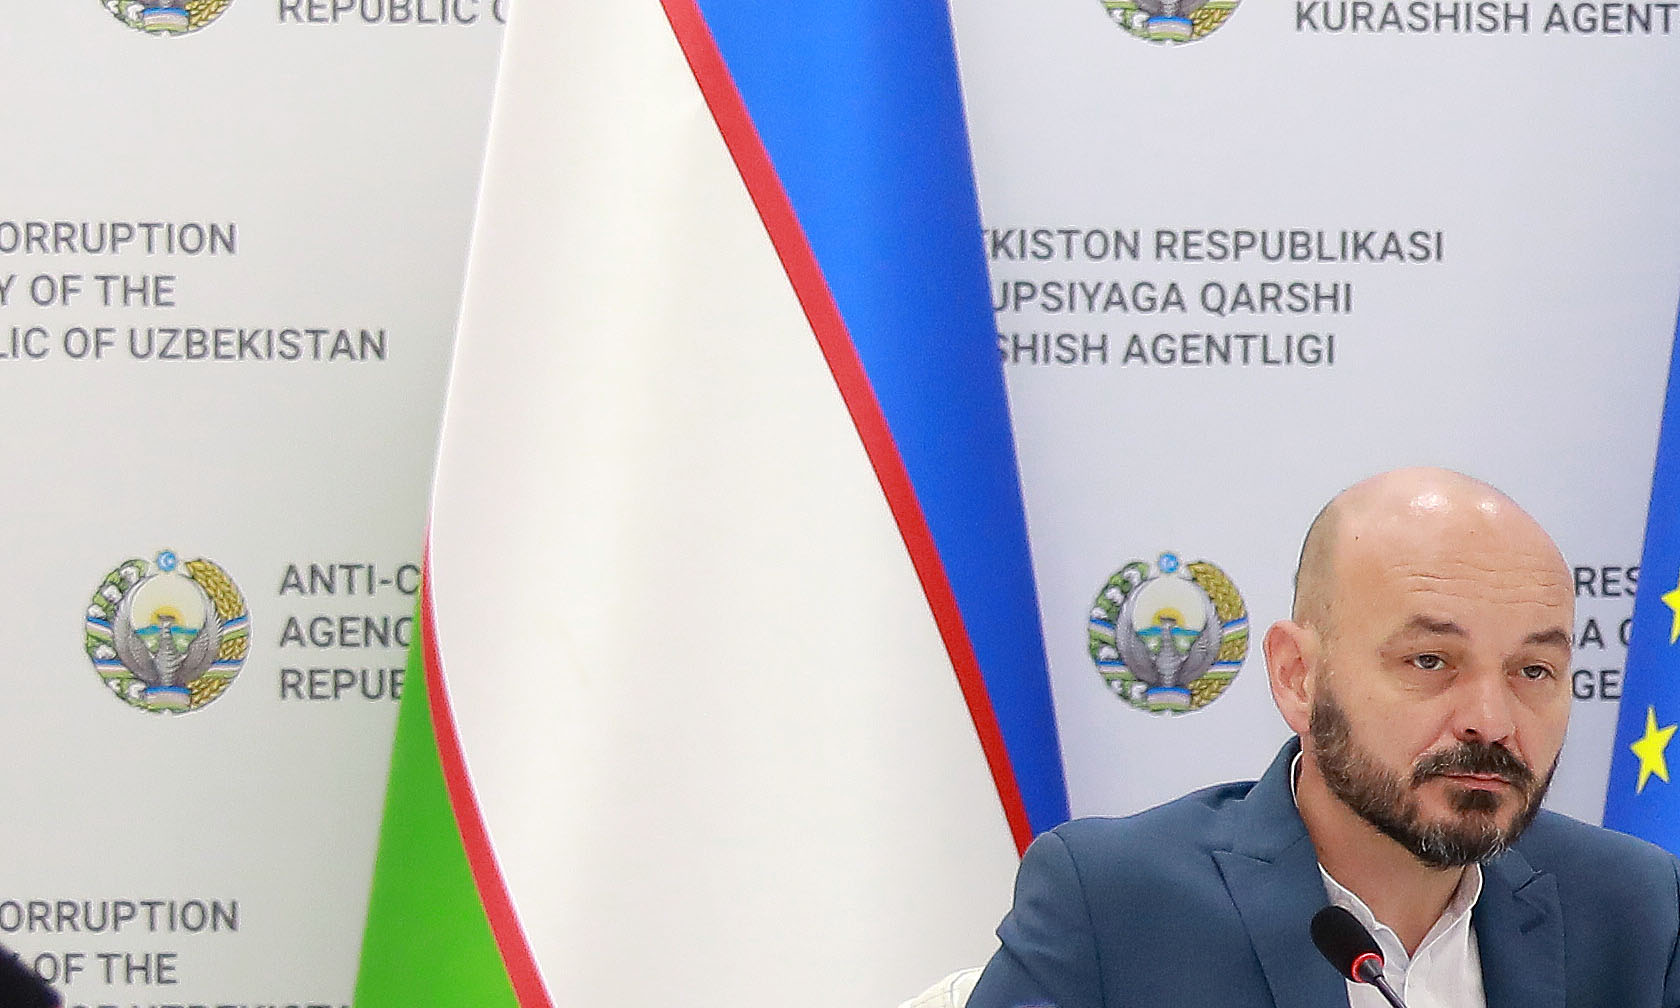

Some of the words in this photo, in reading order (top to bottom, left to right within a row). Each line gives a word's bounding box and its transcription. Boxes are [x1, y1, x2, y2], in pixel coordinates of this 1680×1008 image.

[1295, 0, 1530, 34] KURASHISH
[983, 228, 1141, 263] KISTON
[1154, 228, 1444, 263] RESPUBLIKASI
[29, 273, 83, 307] OF
[93, 274, 177, 308] THE
[1200, 280, 1352, 318] QARSHI
[0, 326, 50, 360] IC
[62, 326, 117, 360] OF
[128, 326, 387, 362] UZBEKISTAN
[1121, 332, 1335, 367] AGENTLIGI
[34, 948, 90, 990] OF
[96, 952, 179, 986] THE
